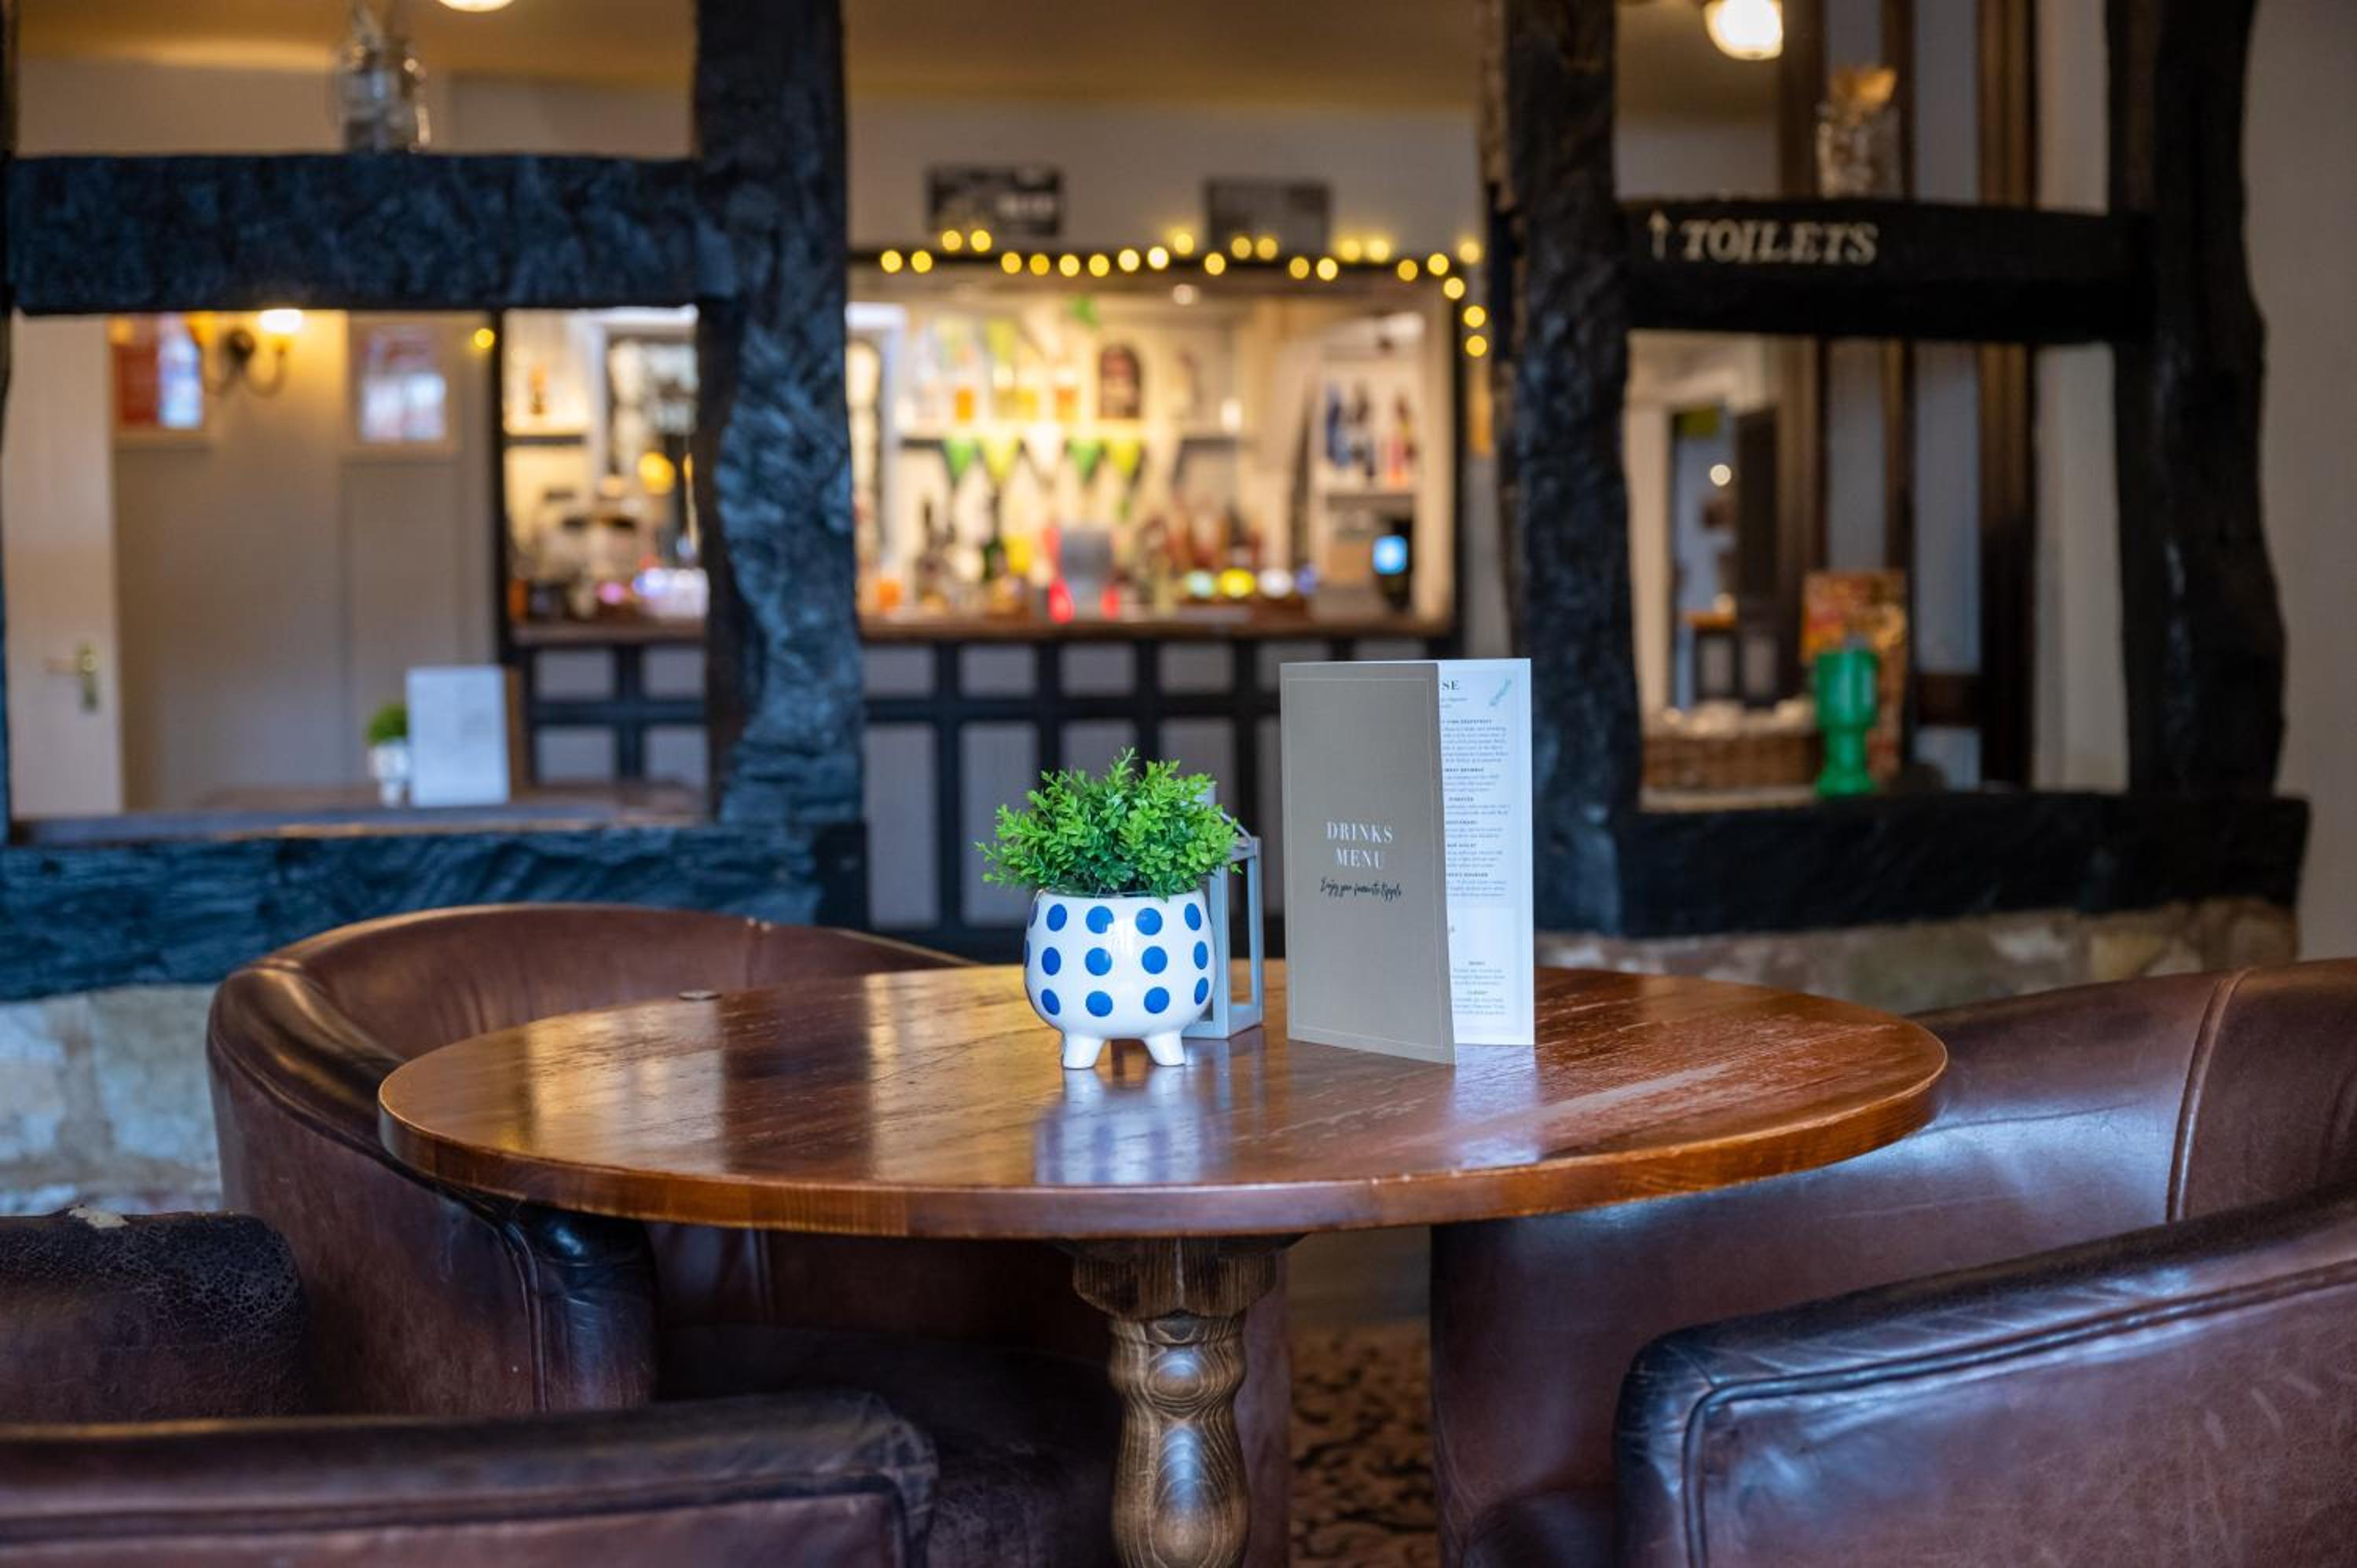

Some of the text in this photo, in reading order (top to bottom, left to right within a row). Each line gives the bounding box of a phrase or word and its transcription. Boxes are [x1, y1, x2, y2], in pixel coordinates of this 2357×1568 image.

[1681, 218, 1879, 264] TOILETS
[1326, 821, 1393, 843] DRINKS
[1336, 847, 1384, 869] MENU
